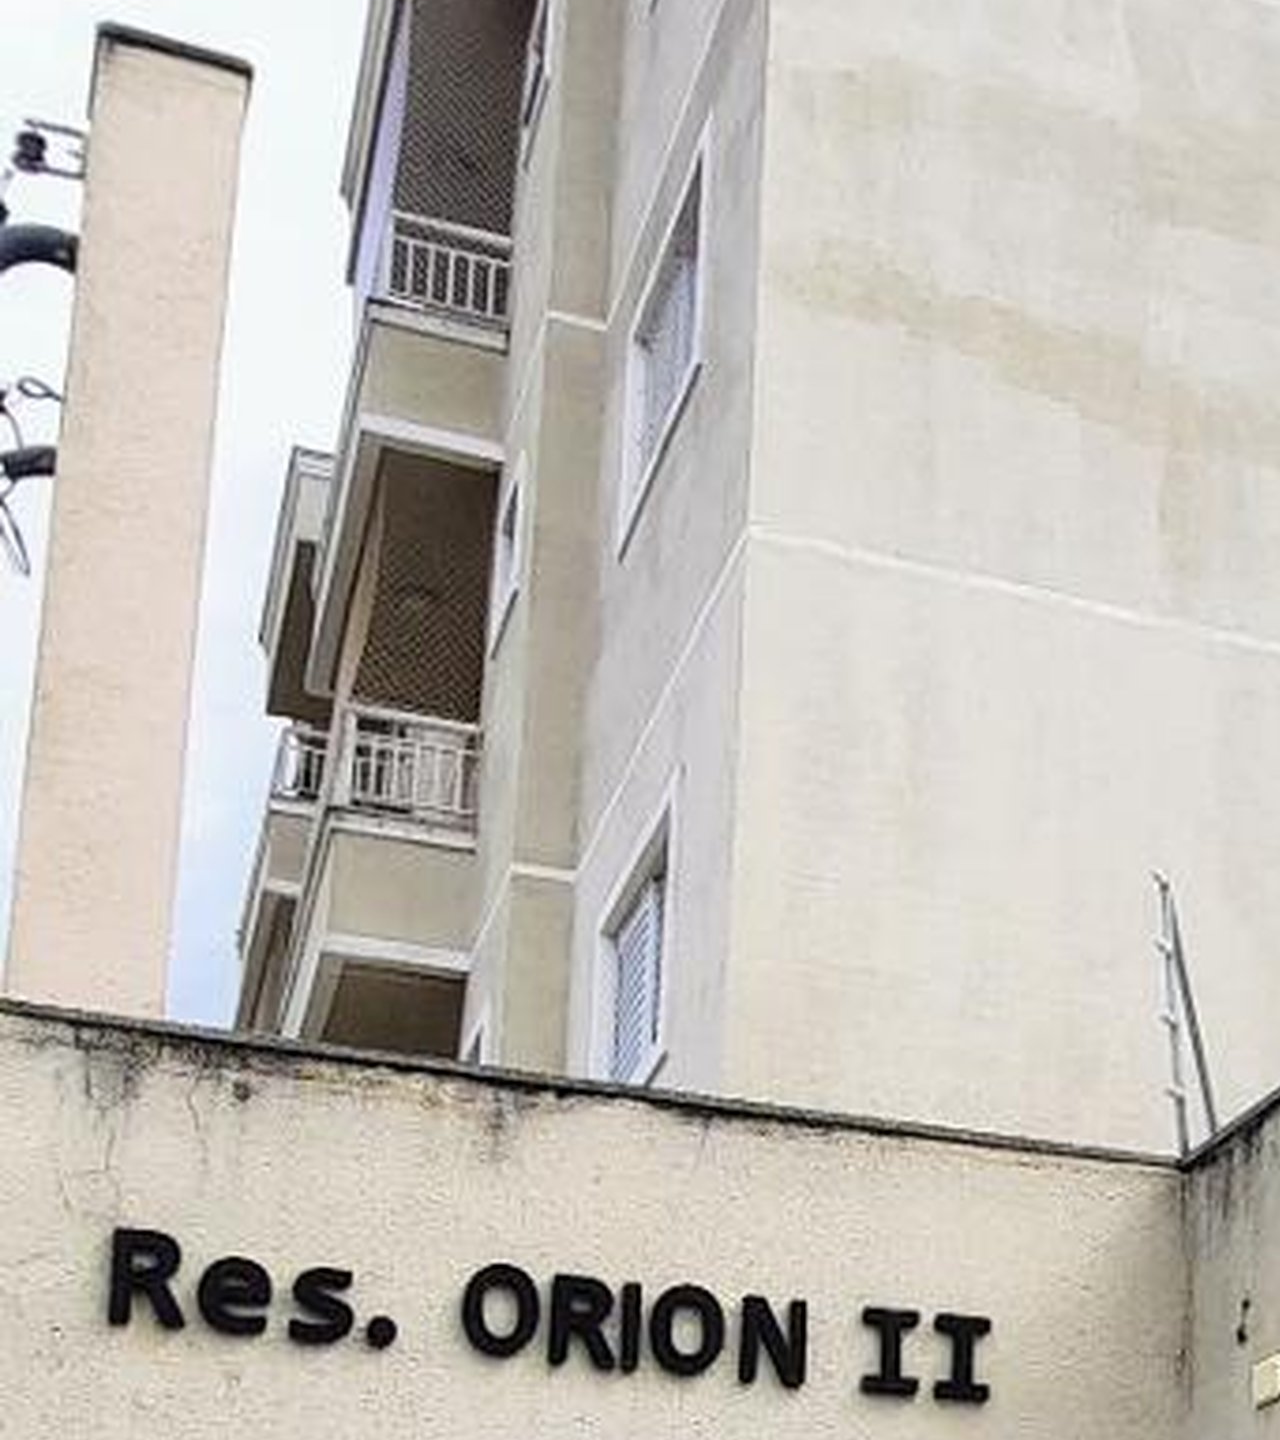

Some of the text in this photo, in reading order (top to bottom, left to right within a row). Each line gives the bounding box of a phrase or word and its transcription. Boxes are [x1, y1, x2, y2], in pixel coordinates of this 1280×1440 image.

[105, 1226, 993, 1408] Res. ORION II
